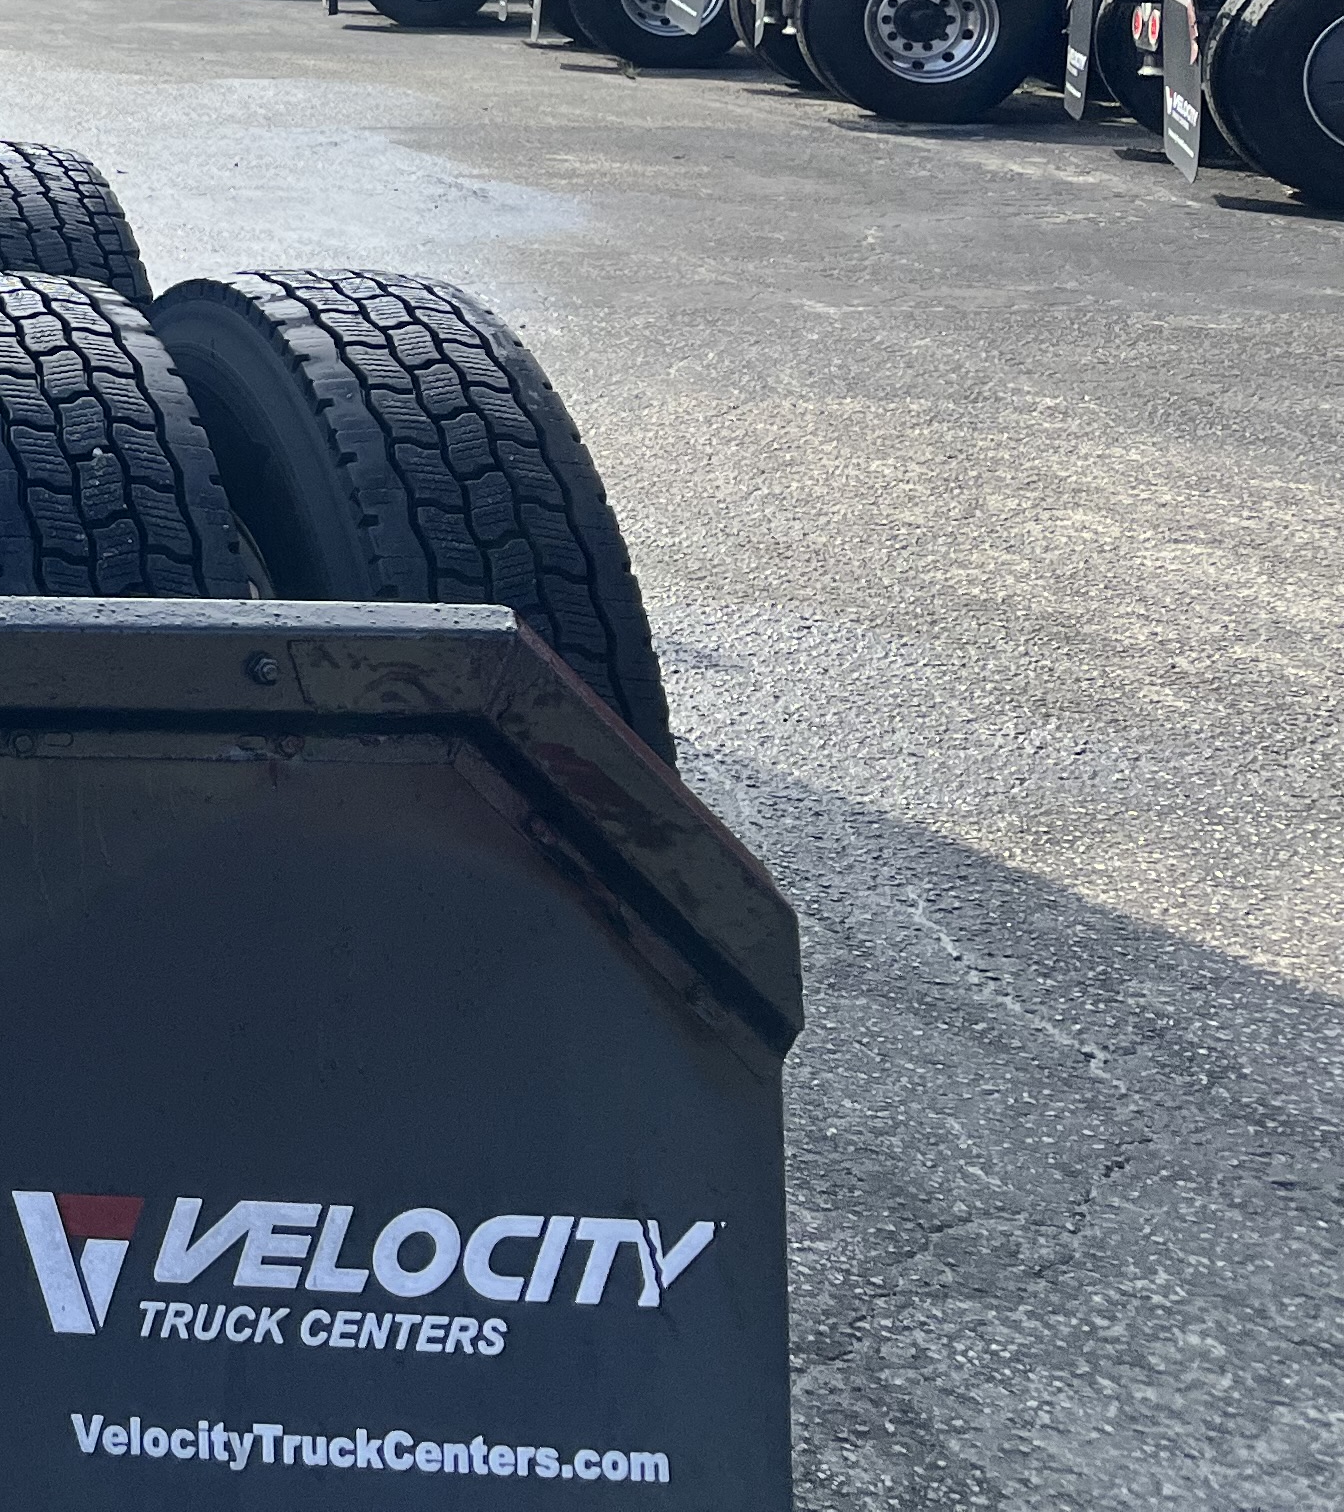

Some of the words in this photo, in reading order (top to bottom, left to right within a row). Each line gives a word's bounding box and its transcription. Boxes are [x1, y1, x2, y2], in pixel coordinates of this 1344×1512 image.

[153, 1196, 717, 1308] VELOCITY
[138, 1300, 286, 1345] TRUCK
[300, 1308, 509, 1357] CENTERS
[71, 1413, 670, 1483] VelocityTruckCenters.com
